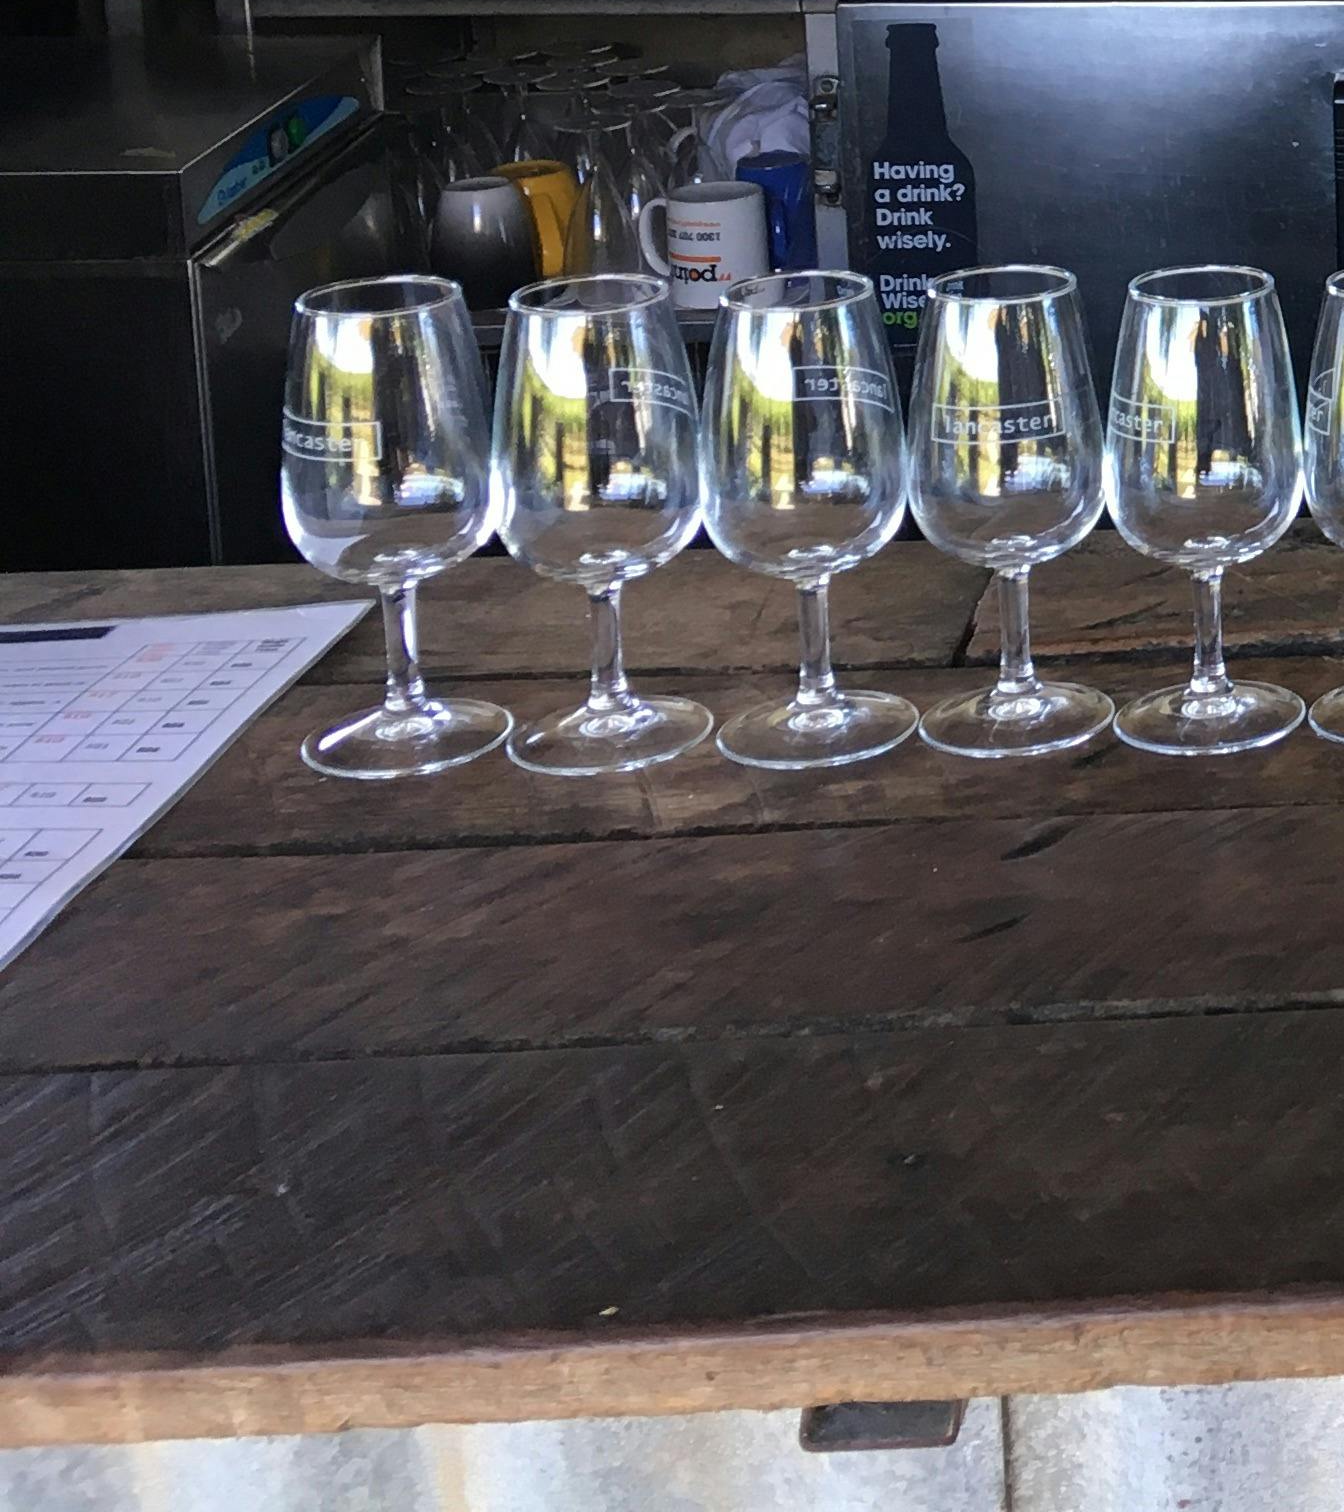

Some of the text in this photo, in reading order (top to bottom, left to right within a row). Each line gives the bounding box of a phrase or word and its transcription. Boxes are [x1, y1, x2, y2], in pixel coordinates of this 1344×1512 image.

[873, 161, 955, 183] Having
[874, 183, 966, 203] a drink?
[875, 207, 934, 226] Drink
[876, 230, 952, 252] wisely.
